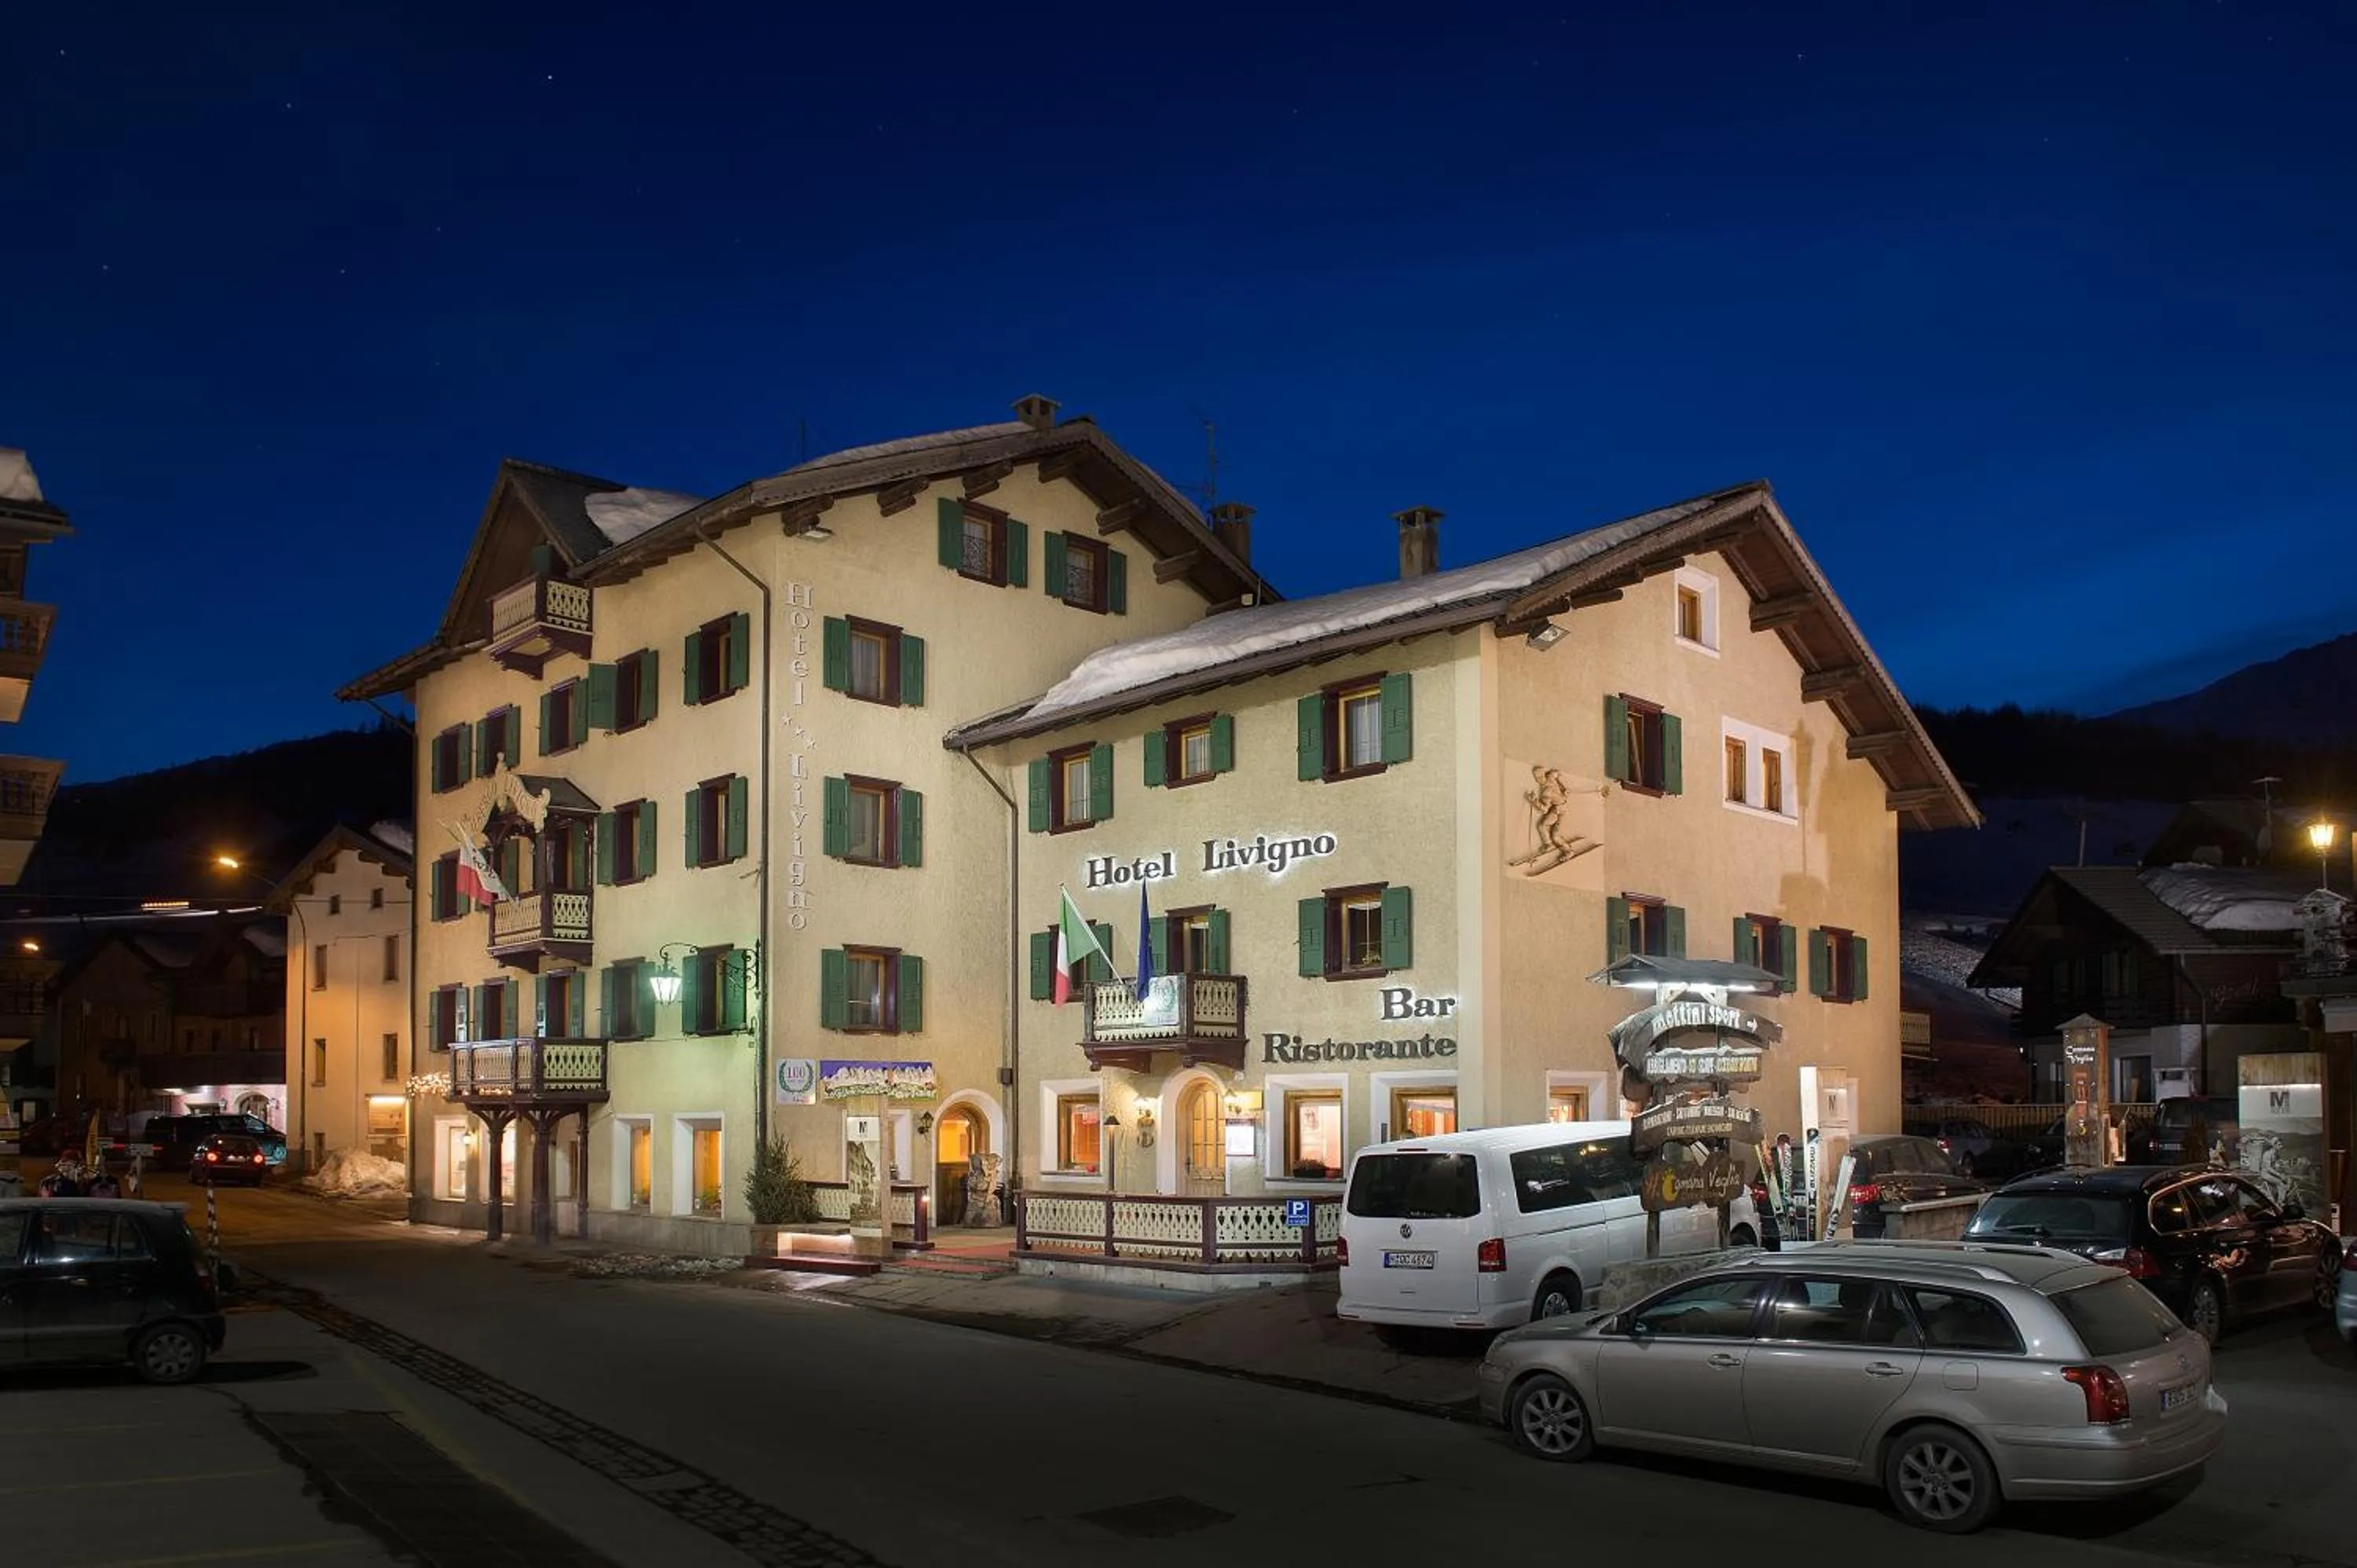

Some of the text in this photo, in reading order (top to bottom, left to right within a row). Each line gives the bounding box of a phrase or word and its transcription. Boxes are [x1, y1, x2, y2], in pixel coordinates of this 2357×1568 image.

[786, 582, 813, 931] Hotel Livigno
[1086, 834, 1336, 888] Hotel Livigno
[1380, 987, 1457, 1020] Bar
[1261, 1032, 1458, 1064] Ristorante
[1292, 1201, 1304, 1215] P
